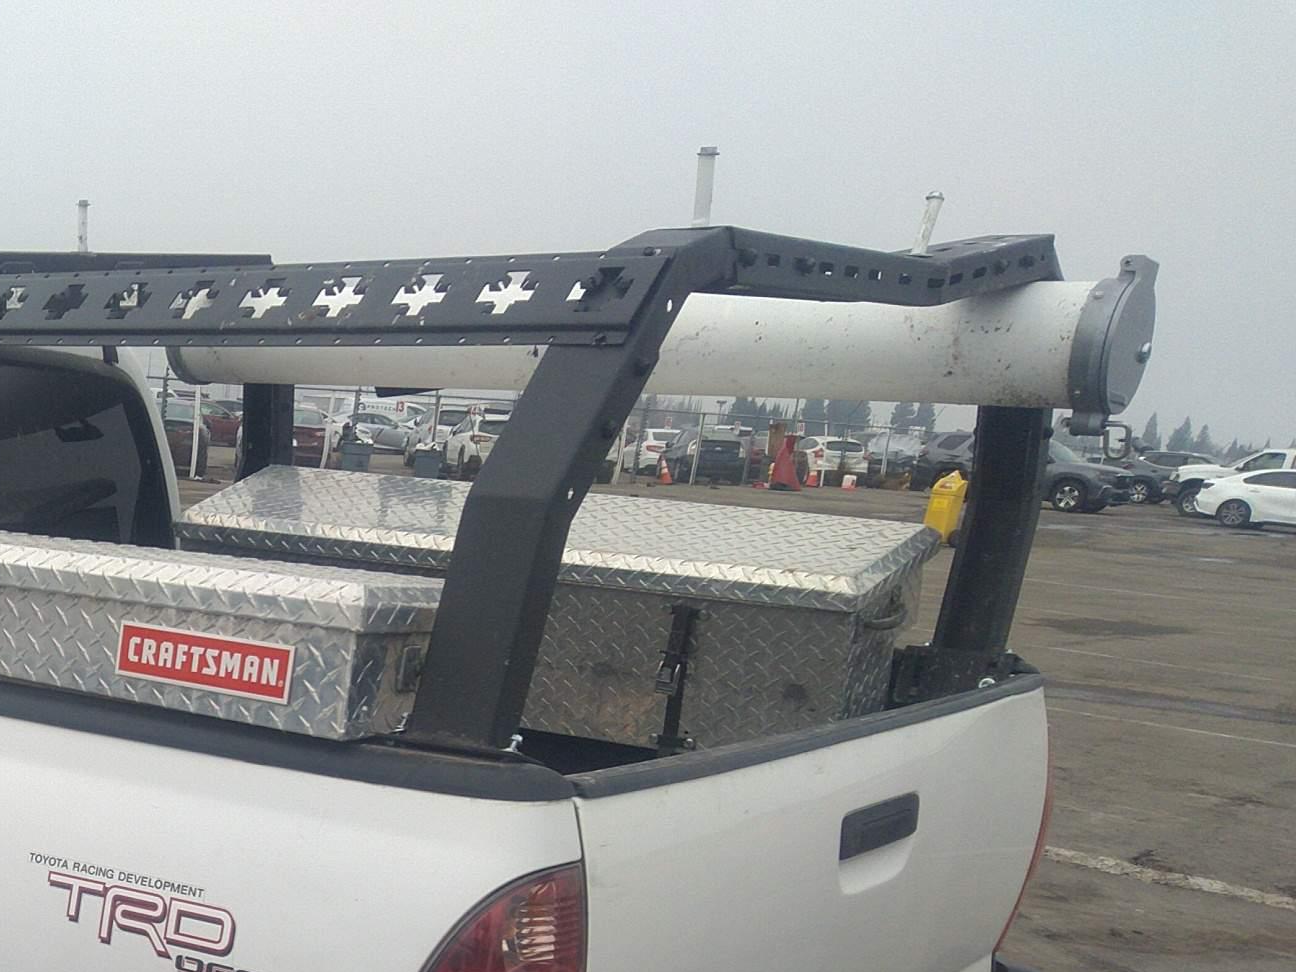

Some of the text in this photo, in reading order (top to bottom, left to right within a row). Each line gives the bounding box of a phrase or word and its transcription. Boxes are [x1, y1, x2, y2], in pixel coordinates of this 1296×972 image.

[127, 636, 281, 688] CRAFTSMAN
[29, 852, 205, 898] TOYOTA RACING DEVELOPMENT
[47, 870, 236, 960] TRD
